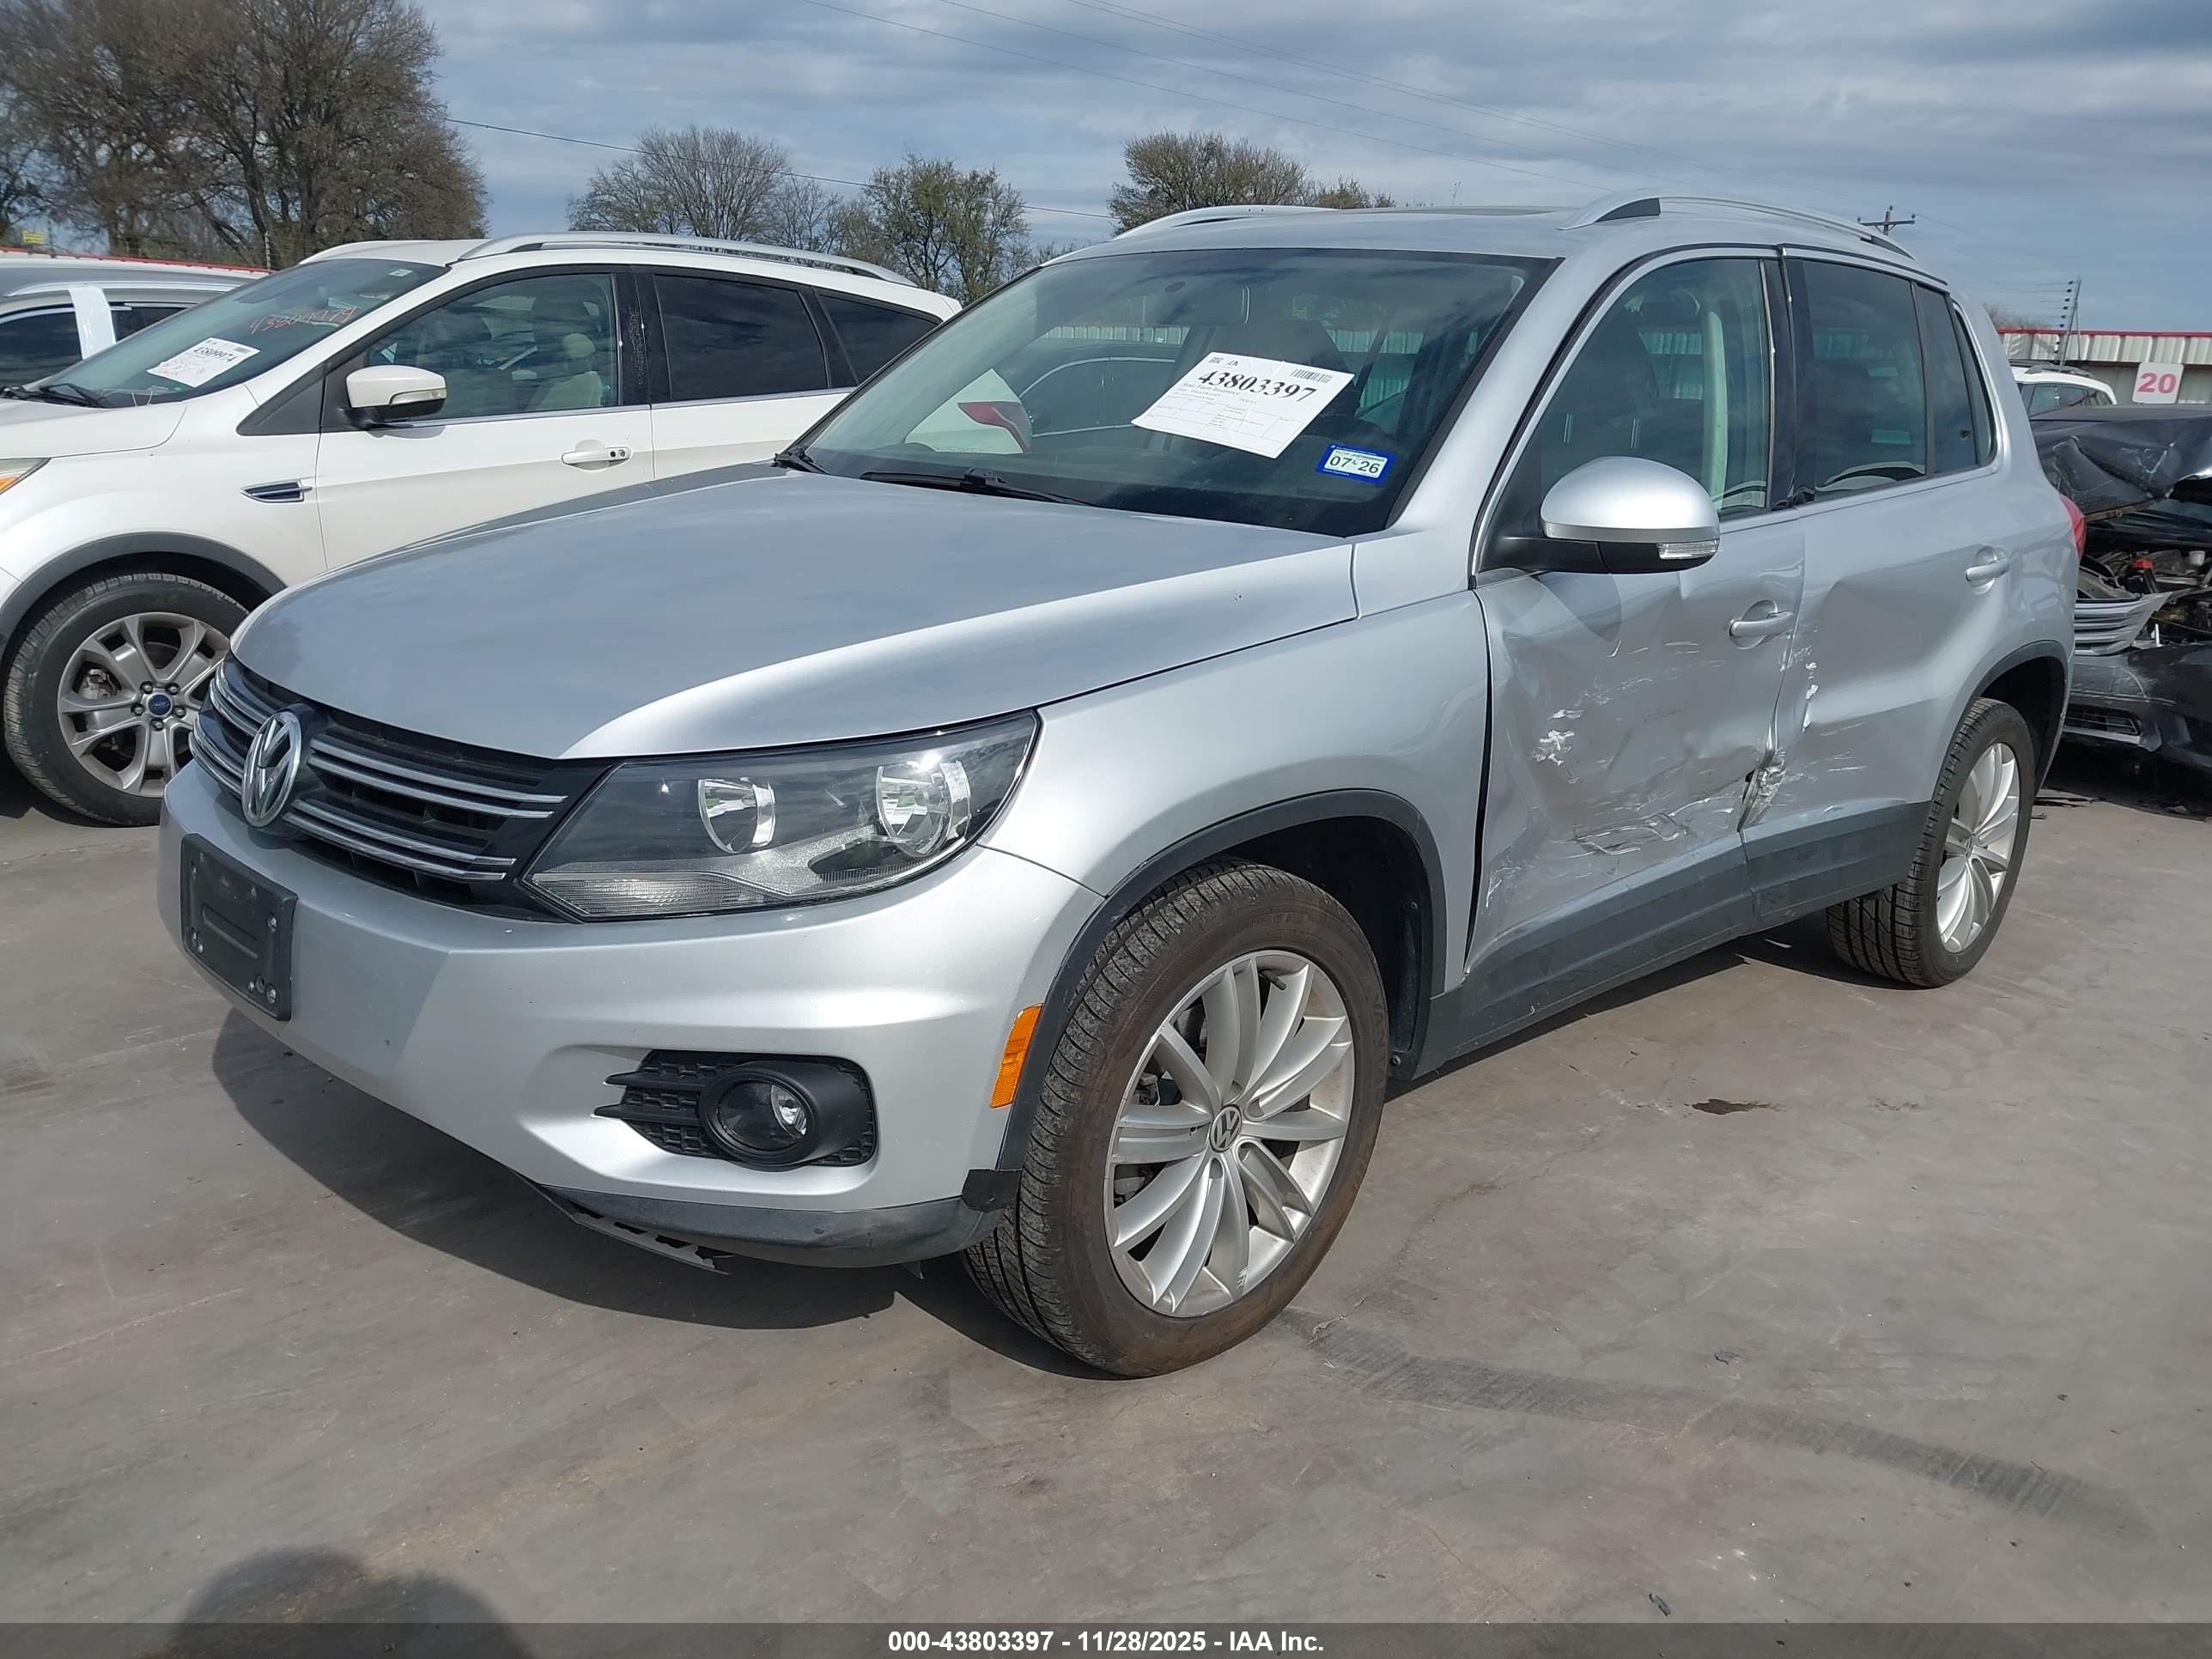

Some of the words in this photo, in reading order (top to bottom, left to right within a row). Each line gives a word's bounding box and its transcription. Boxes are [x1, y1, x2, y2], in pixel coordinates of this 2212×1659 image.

[1199, 371, 1317, 402] 43803397
[2138, 372, 2176, 393] 20
[1329, 456, 1352, 468] 07
[1358, 460, 1381, 474] 26
